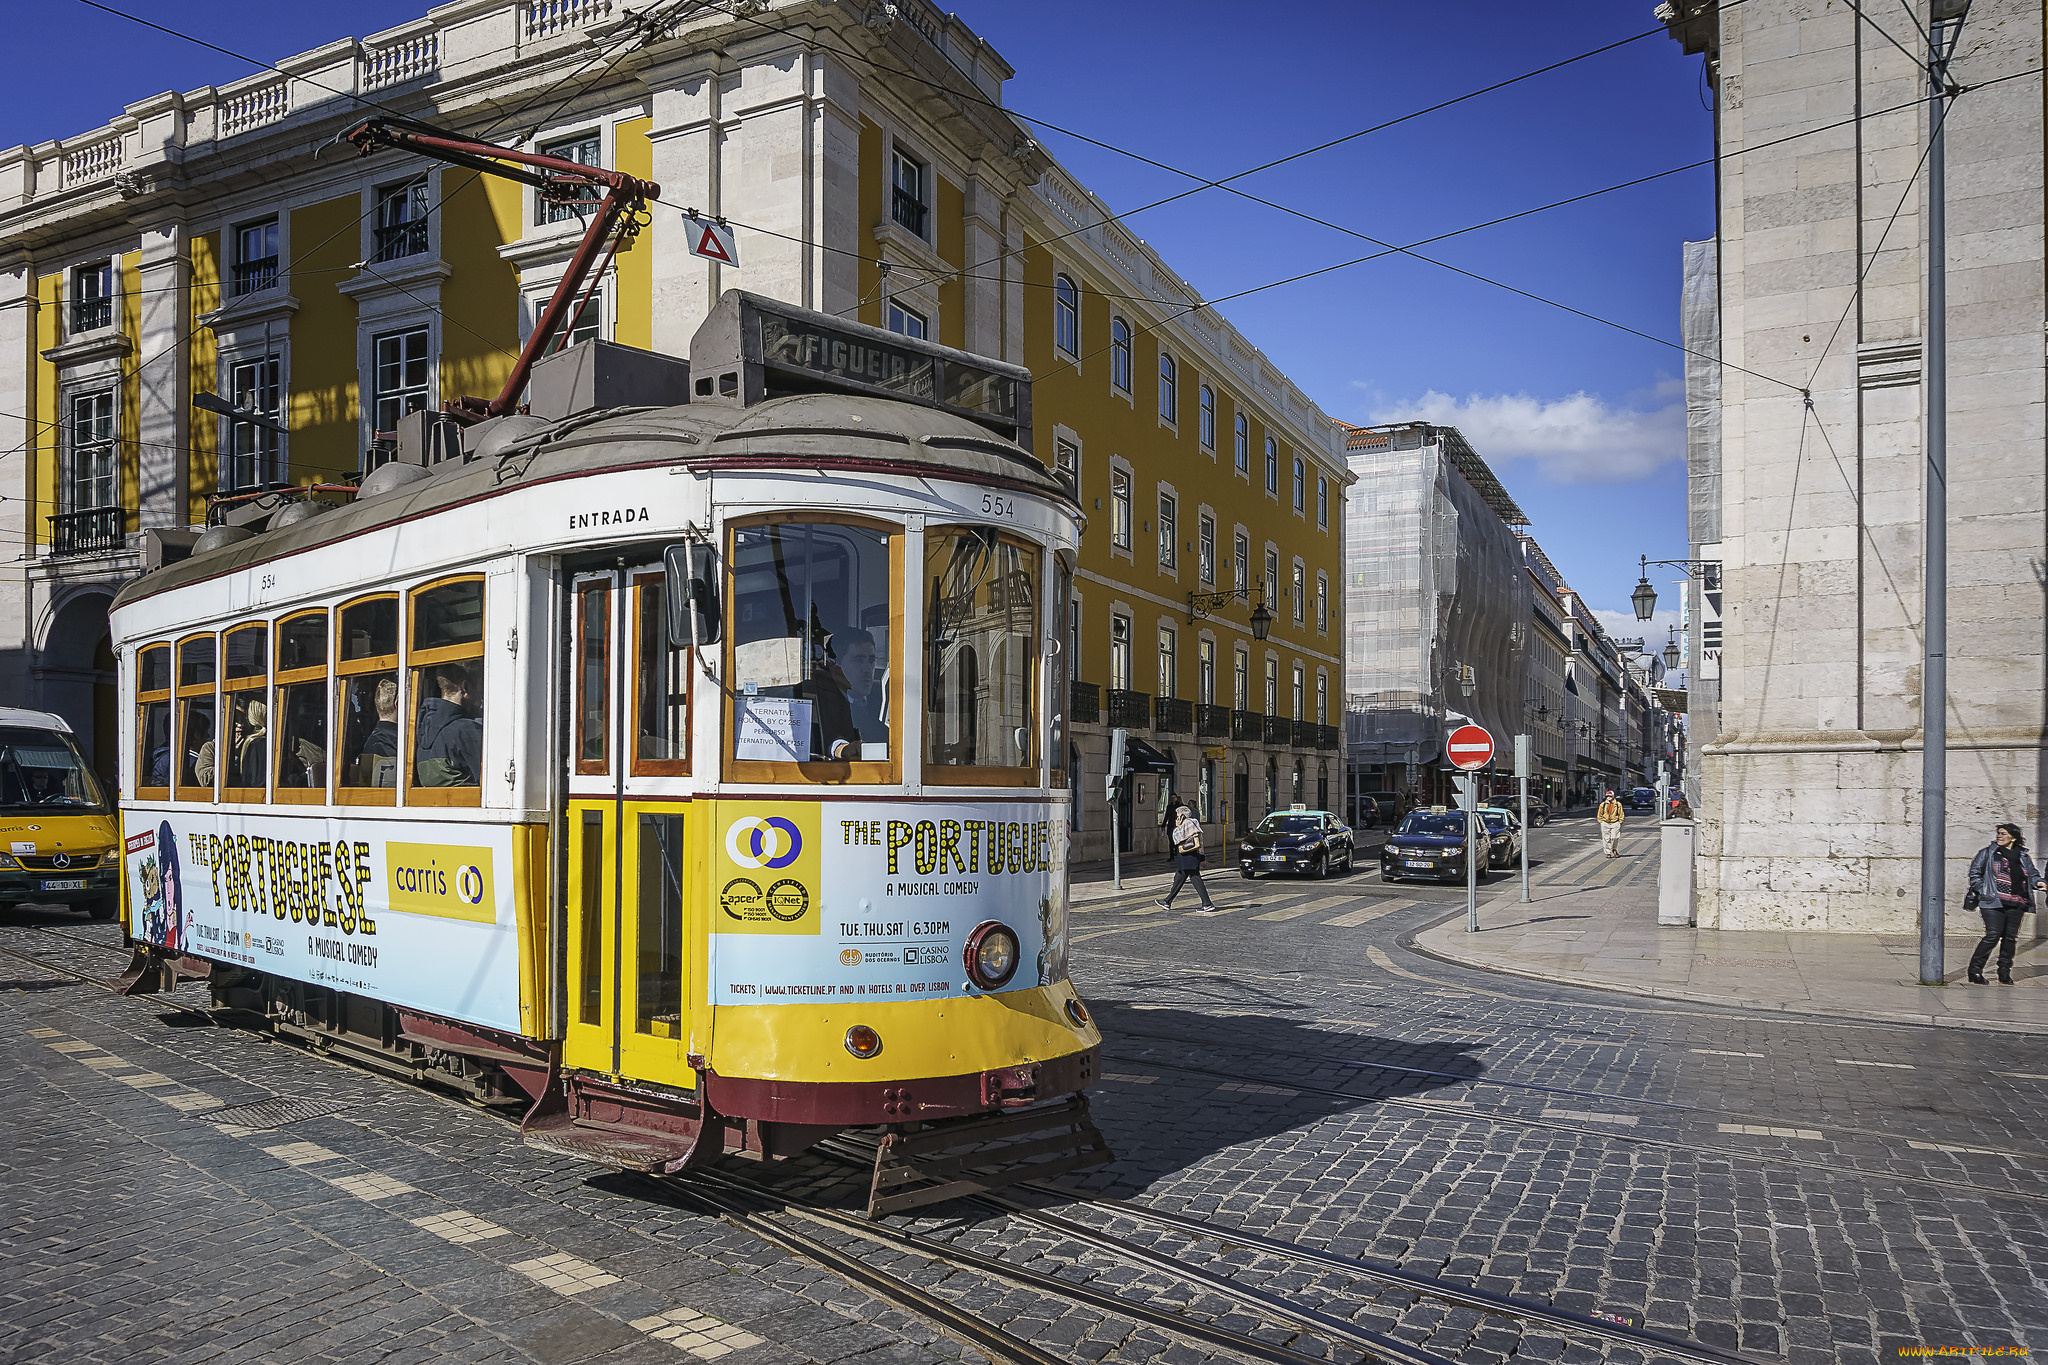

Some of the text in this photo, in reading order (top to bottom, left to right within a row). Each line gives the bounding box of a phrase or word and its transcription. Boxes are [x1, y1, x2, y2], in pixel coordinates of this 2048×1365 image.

[981, 494, 1014, 518] 554
[569, 507, 650, 529] ENTRADA
[261, 574, 276, 590] 554
[841, 820, 881, 845] THE
[887, 819, 1063, 876] PORTUGUESE
[189, 833, 377, 936] THE PORTUGUESE
[396, 859, 447, 896] carris
[886, 881, 979, 897] A MUSICAL COMEDY
[727, 895, 757, 906] apcer
[774, 896, 801, 906] IQNet
[840, 921, 950, 936] TUE.THU.SAT 6.30PM
[308, 936, 378, 968] A MUSICAL COMEDY
[920, 946, 950, 955] CASINO
[920, 955, 949, 965] LISBOA
[729, 981, 950, 995] TICKETS WWW.TICKETLINE.PT AND IN HOTELS ALL OVER LISBON
